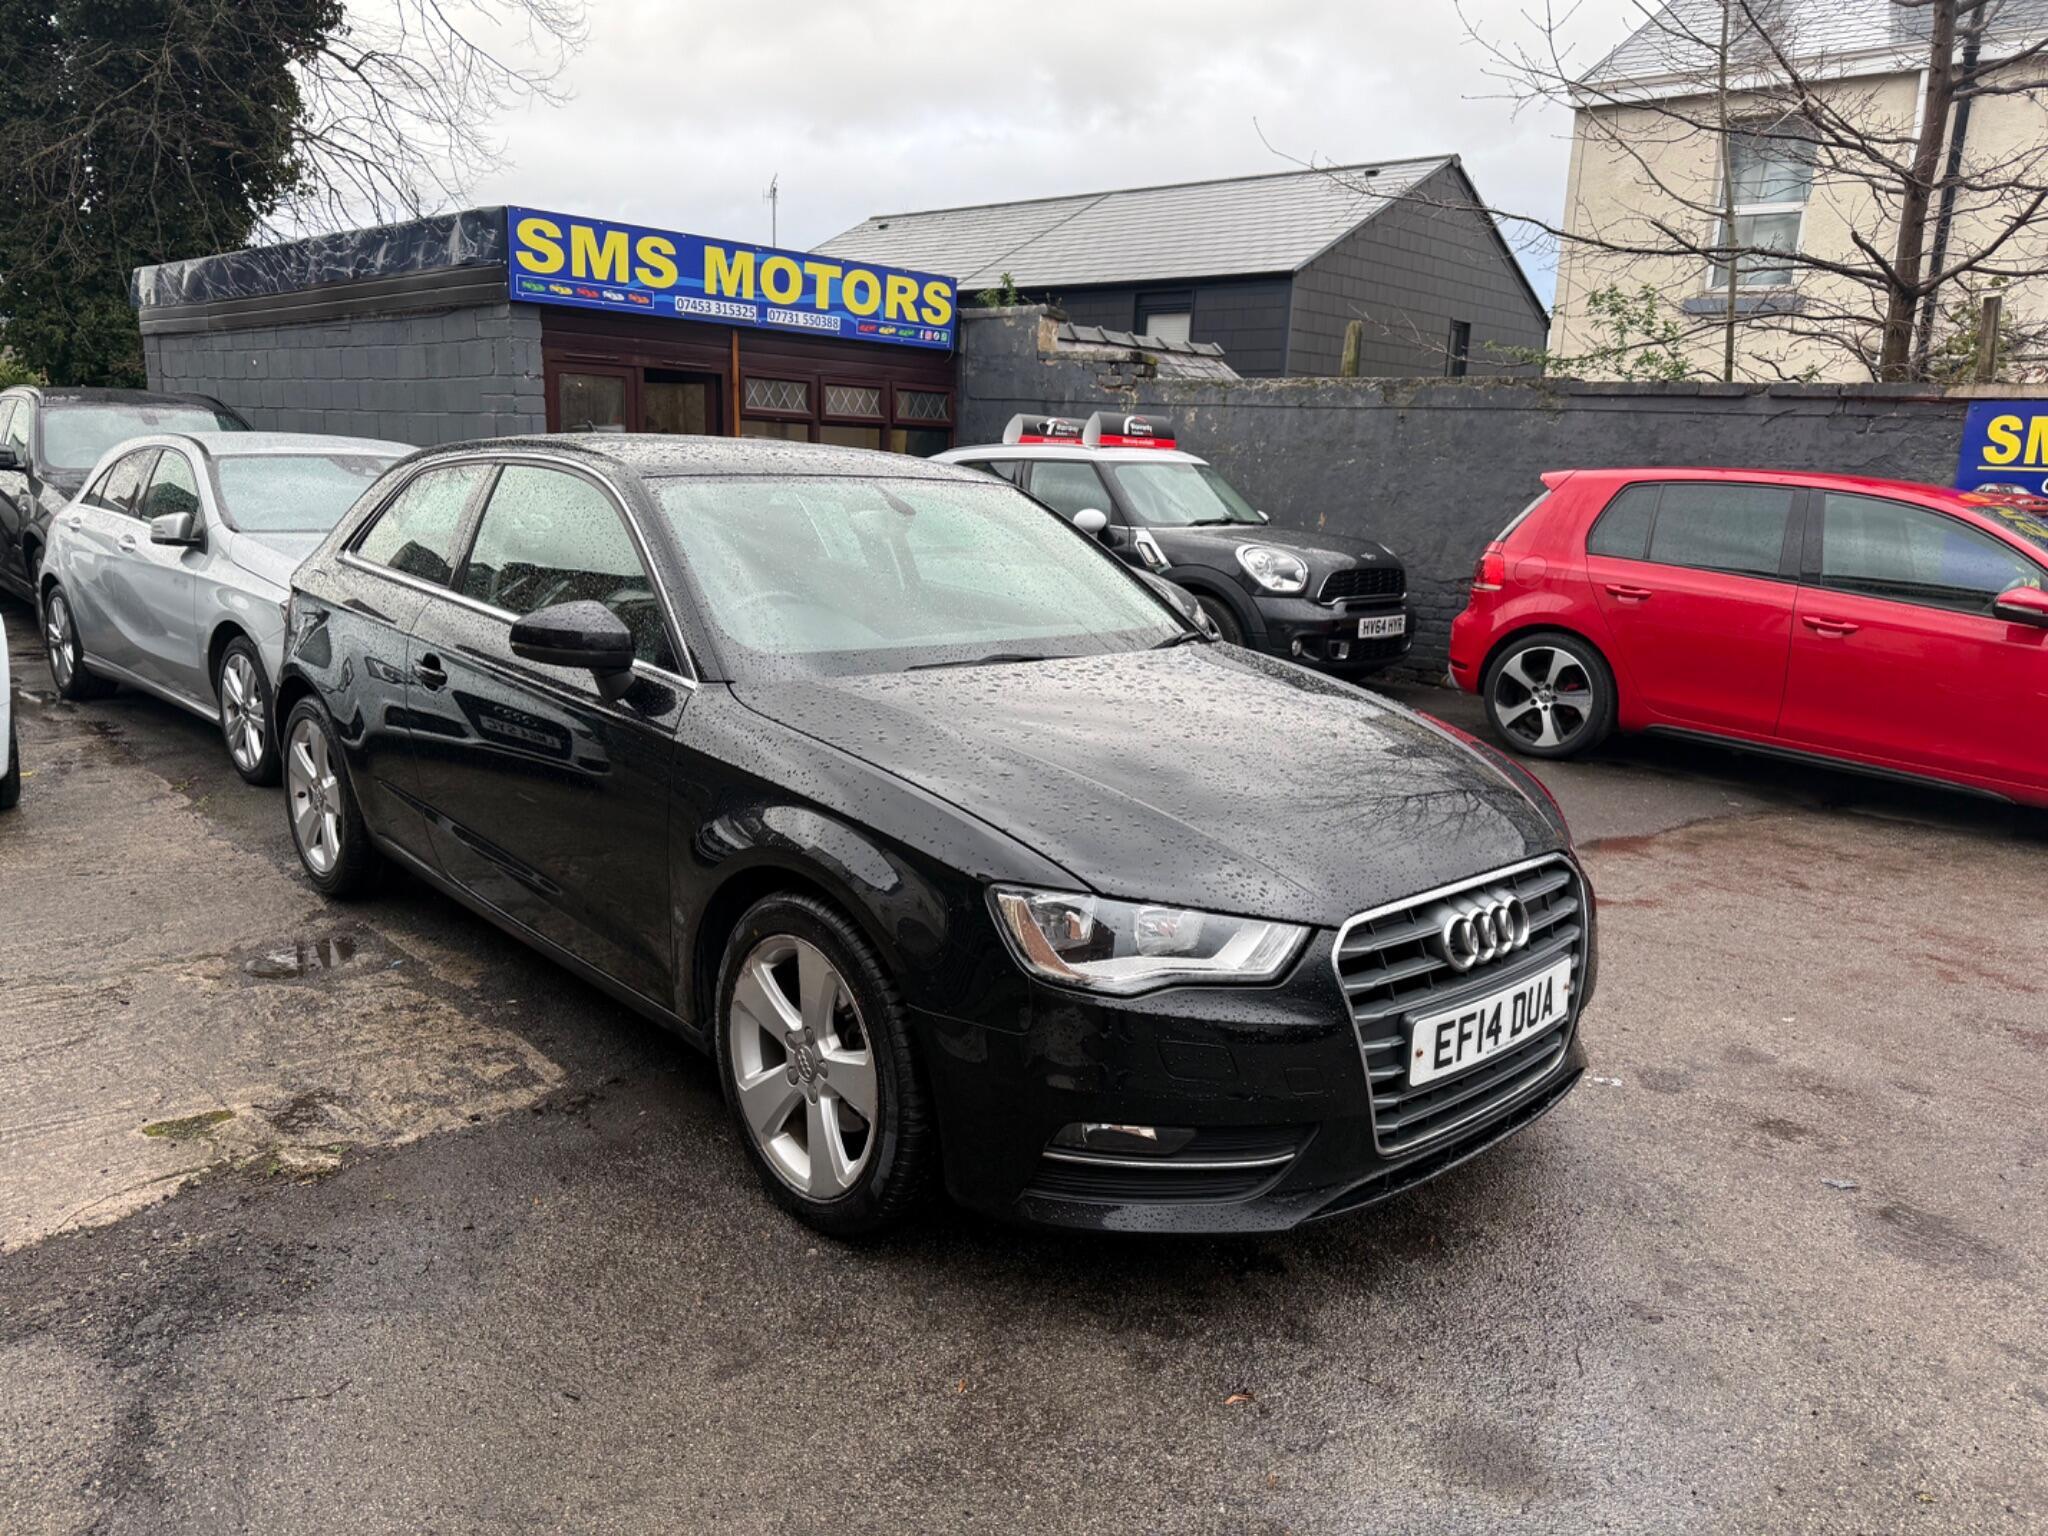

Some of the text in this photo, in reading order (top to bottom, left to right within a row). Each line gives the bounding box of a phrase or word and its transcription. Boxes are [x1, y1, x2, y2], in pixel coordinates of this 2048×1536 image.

[515, 217, 952, 326] SMS MOTORS
[676, 297, 756, 319] 07453 315325
[768, 309, 840, 329] 07731 550388
[1363, 619, 1387, 635] HV64
[1433, 975, 1553, 1070] EF14 DUA
